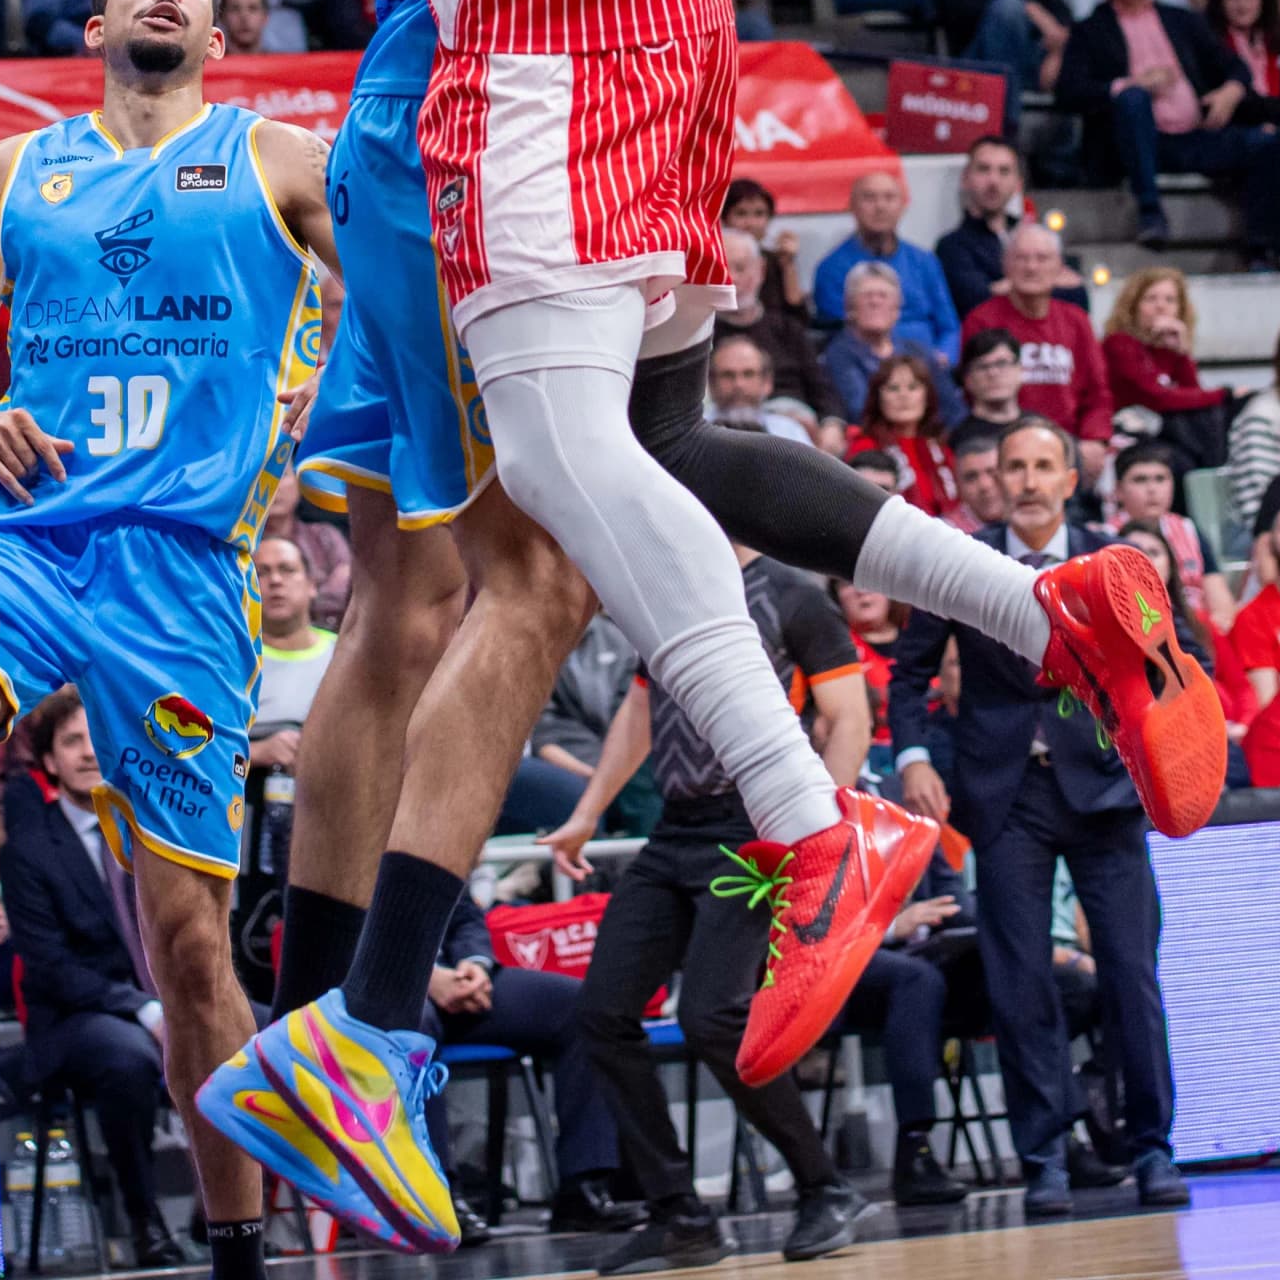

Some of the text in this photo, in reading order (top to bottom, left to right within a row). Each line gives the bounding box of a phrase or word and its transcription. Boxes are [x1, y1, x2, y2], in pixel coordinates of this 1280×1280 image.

[179, 178, 223, 188] endesa
[180, 170, 201, 181] liga
[25, 294, 233, 329] DREAMLAND
[53, 331, 230, 361] GranCanaria
[1020, 341, 1074, 368] CAM
[86, 375, 171, 457] 30
[120, 746, 214, 799] Poema
[157, 784, 210, 820] Mar
[551, 921, 598, 945] UCA
